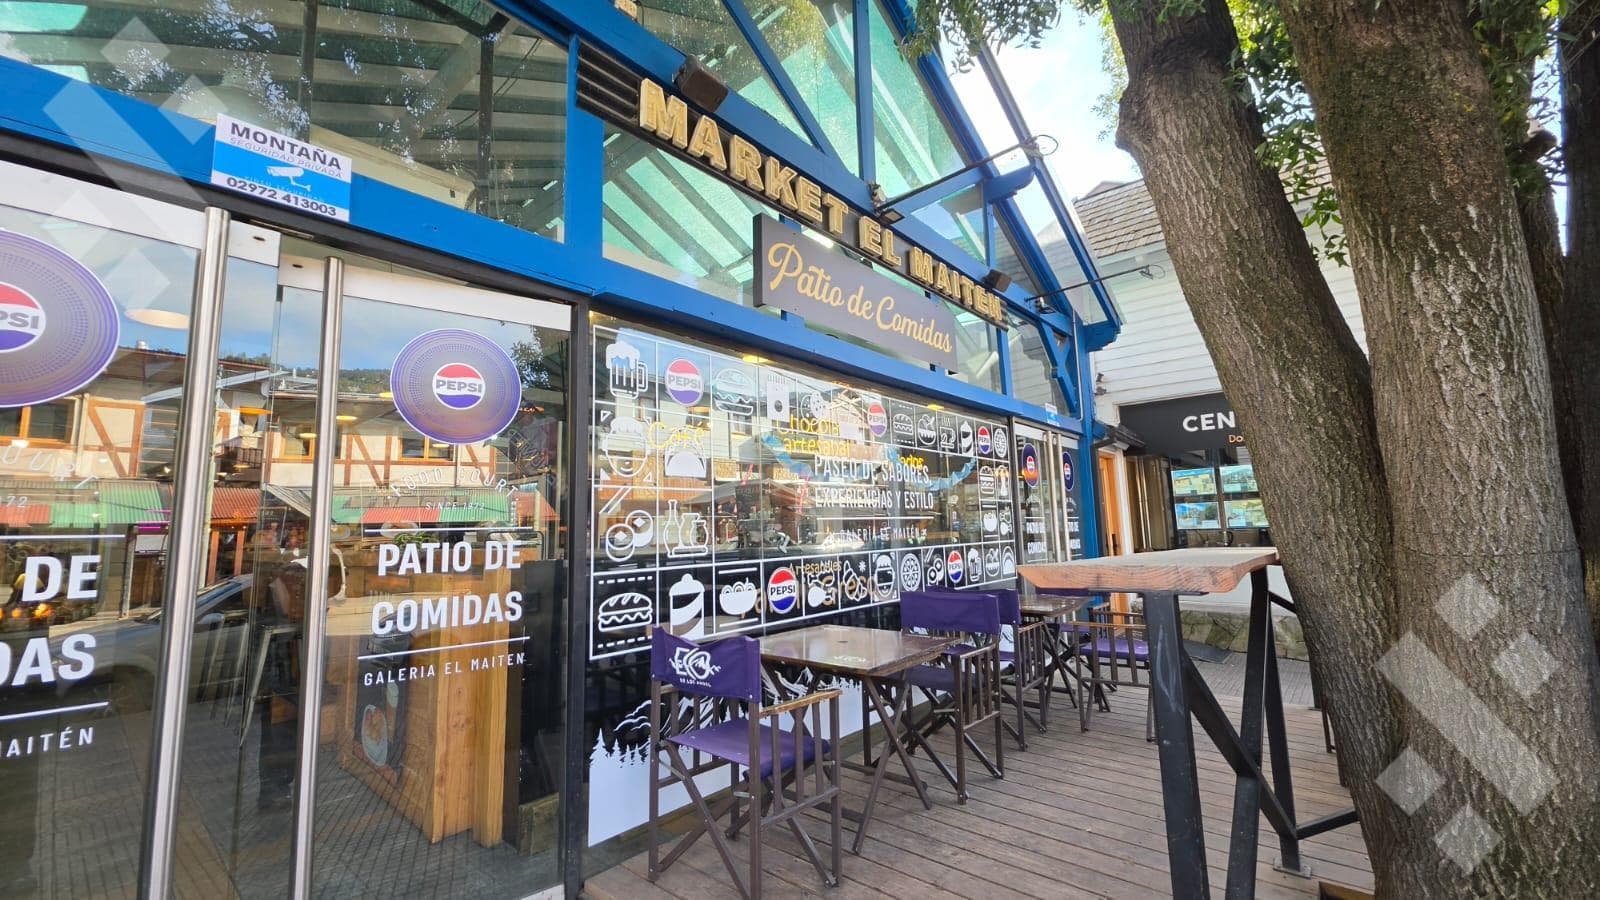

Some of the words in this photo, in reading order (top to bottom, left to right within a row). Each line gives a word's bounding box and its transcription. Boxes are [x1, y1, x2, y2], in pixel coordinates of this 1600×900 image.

[230, 138, 295, 163] SEGURIDAD
[297, 159, 343, 178] PRIVADA
[231, 122, 341, 170] MONTAÑA
[226, 177, 277, 200] 02972
[281, 194, 337, 217] 413003
[640, 78, 849, 236] MARKET
[858, 215, 902, 266] EL
[909, 246, 1003, 321] MAITEN
[768, 242, 844, 307] Patio
[847, 284, 875, 319] de
[876, 296, 953, 353] Comidas
[0, 311, 39, 329] SI
[436, 379, 482, 393] PEPSI
[667, 373, 701, 389] PEPSI
[1182, 411, 1236, 432] CEN
[1228, 434, 1244, 443] Do
[814, 455, 857, 477] PASEO
[425, 501, 458, 511] SINCE
[815, 488, 893, 509] EXPERIENCIAS
[895, 493, 903, 509] Y
[904, 493, 934, 509] ESTILO
[377, 541, 472, 576] PATIO
[484, 540, 522, 571] DE
[22, 555, 101, 602] DE
[769, 584, 796, 597] PEPSI
[371, 591, 524, 636] COMIDAS
[363, 664, 436, 687] GALERIA
[444, 661, 463, 676] EL
[0, 726, 94, 758] AITÉN
